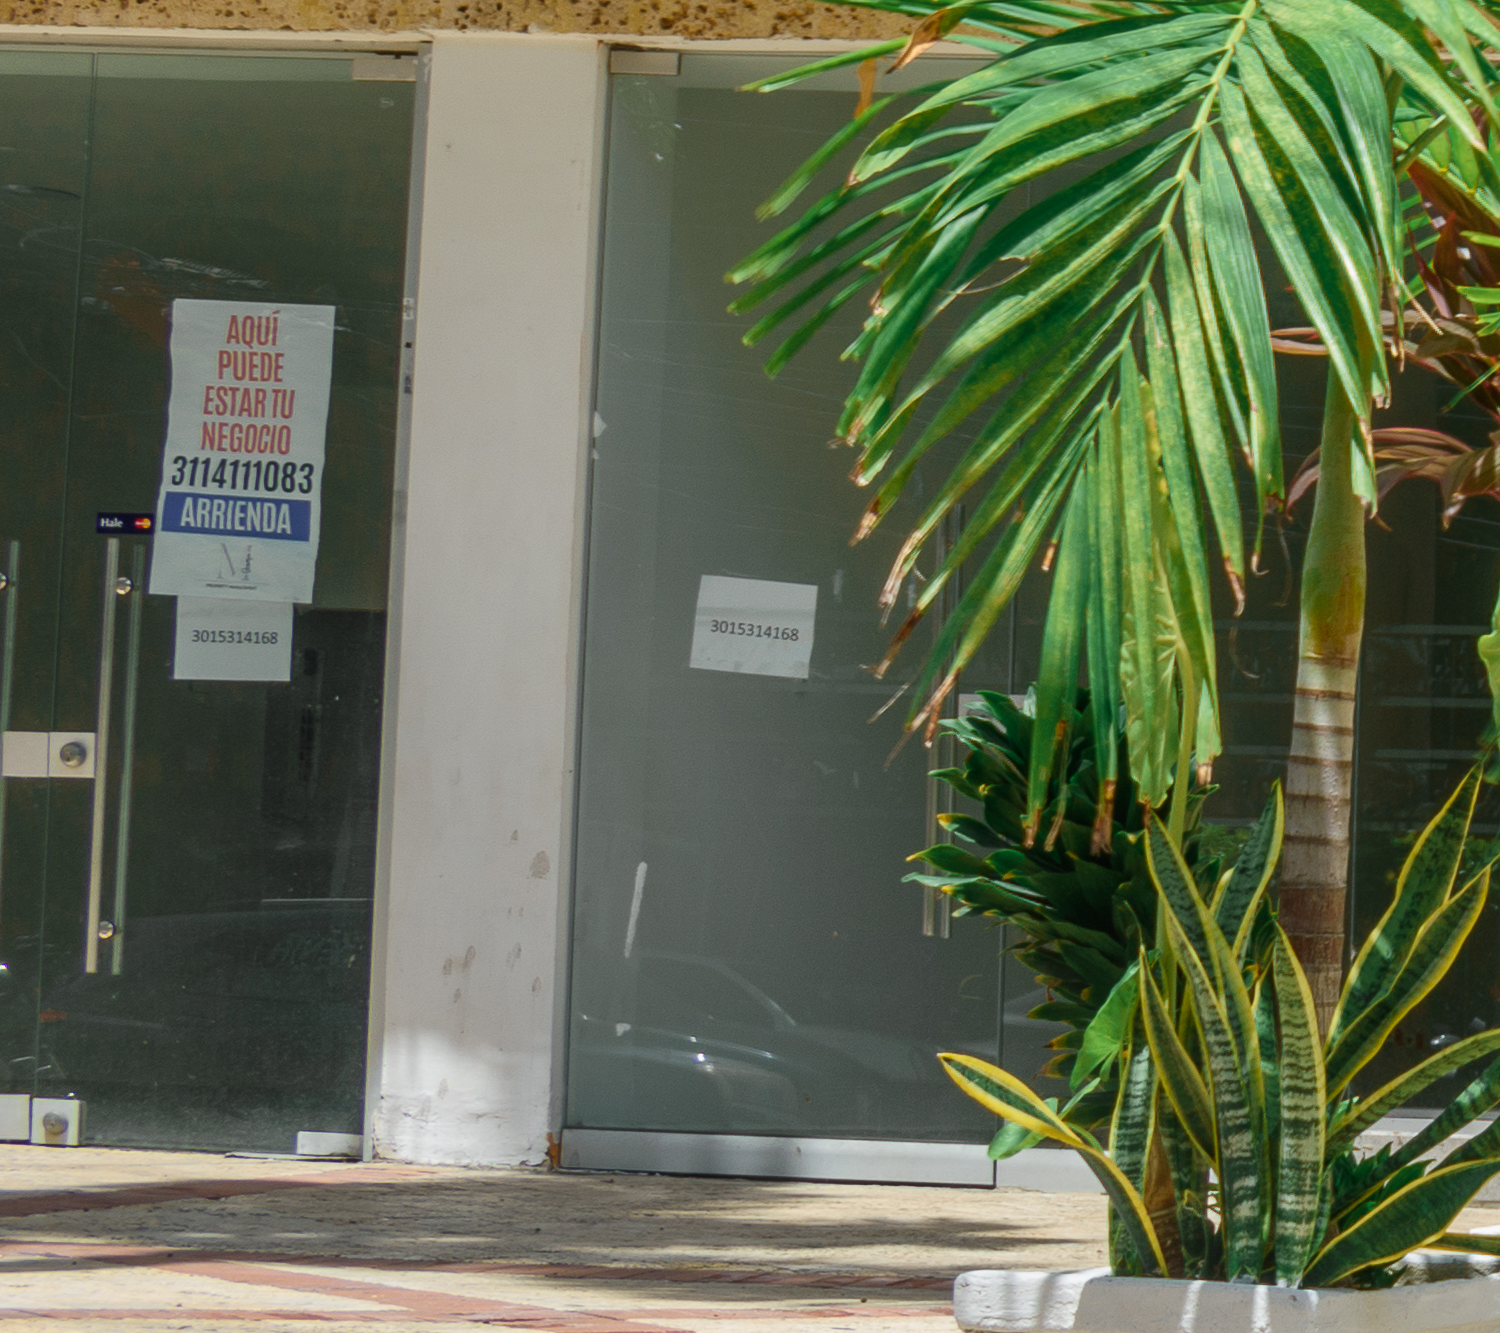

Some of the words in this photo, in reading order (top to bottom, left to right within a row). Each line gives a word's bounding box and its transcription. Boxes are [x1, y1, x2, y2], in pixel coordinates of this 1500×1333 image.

[226, 310, 281, 349] AQUÍ
[217, 350, 285, 383] PUEDE
[203, 385, 267, 418] ESTAR
[272, 388, 296, 419] TU
[201, 421, 292, 455] NEGOCIO
[171, 455, 315, 494] 3114111083
[180, 496, 292, 535] ARRIENDA
[191, 629, 279, 645] 3015314168
[710, 619, 799, 641] 3015314168
